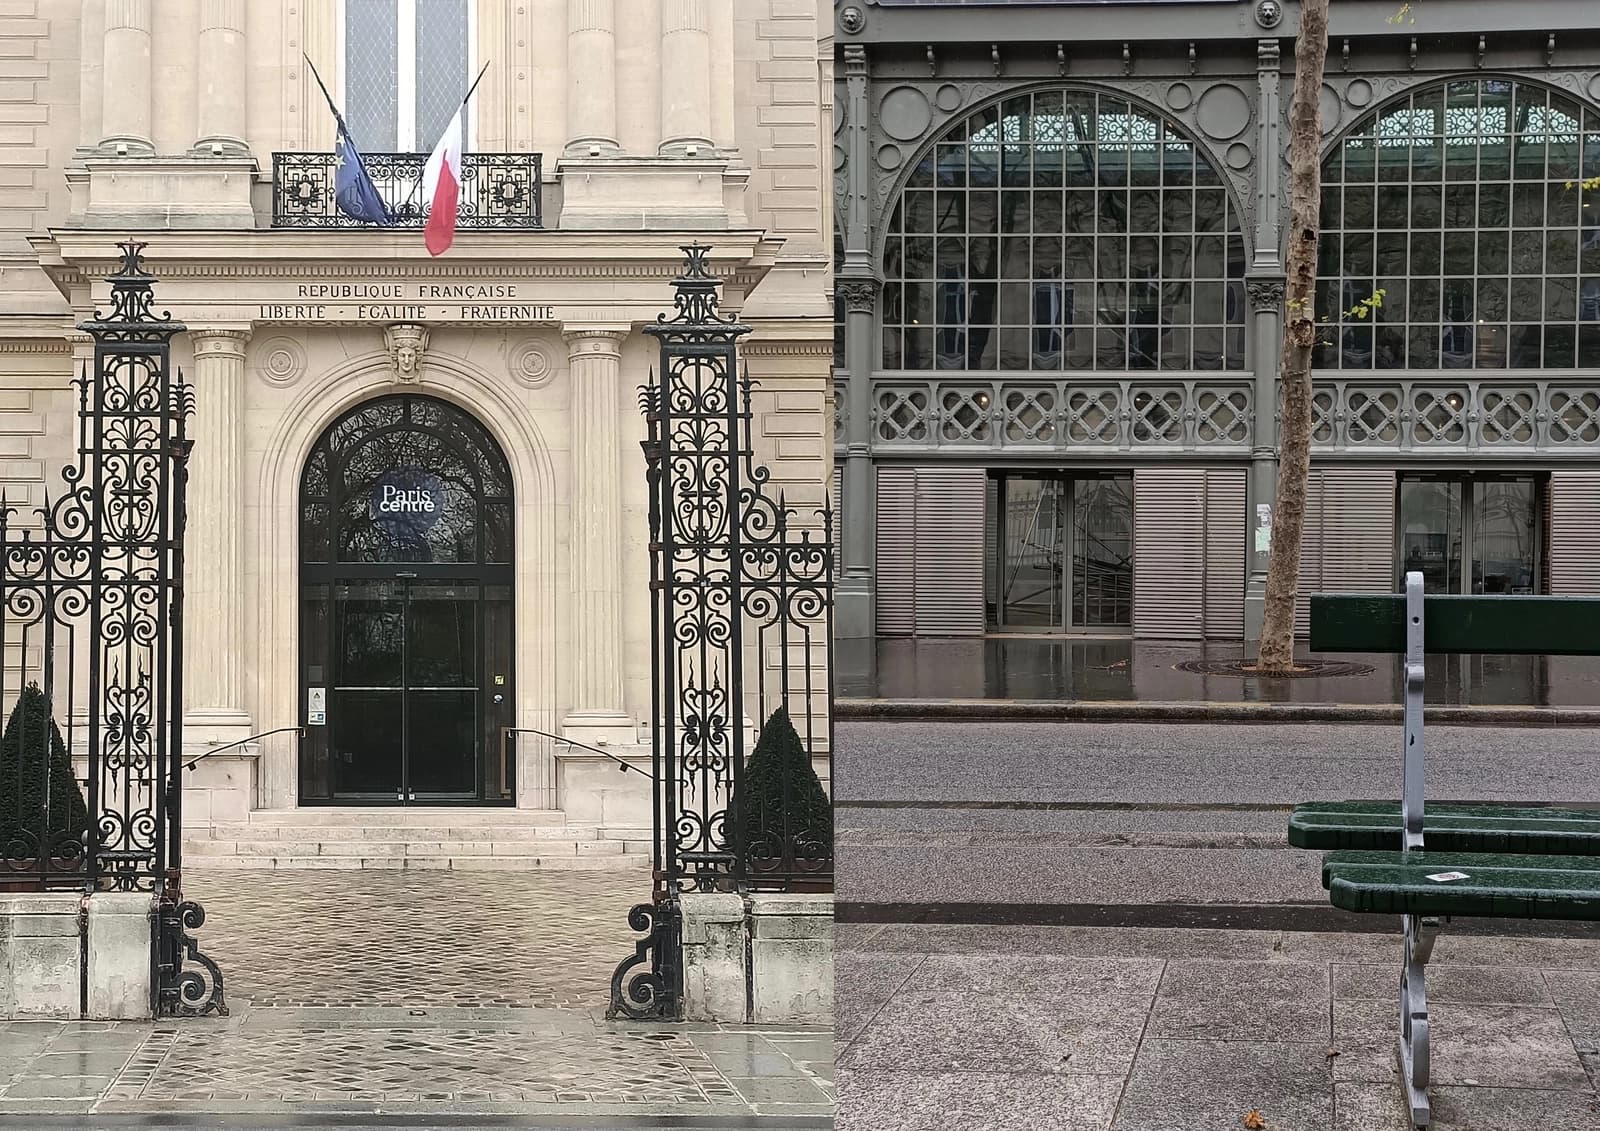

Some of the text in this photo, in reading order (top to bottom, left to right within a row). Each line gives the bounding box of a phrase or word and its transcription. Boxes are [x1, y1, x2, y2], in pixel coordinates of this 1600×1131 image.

[298, 285, 517, 299] REPUBLIQUE FRANÇAISE
[382, 484, 431, 502] Paris
[379, 500, 435, 512] centre
